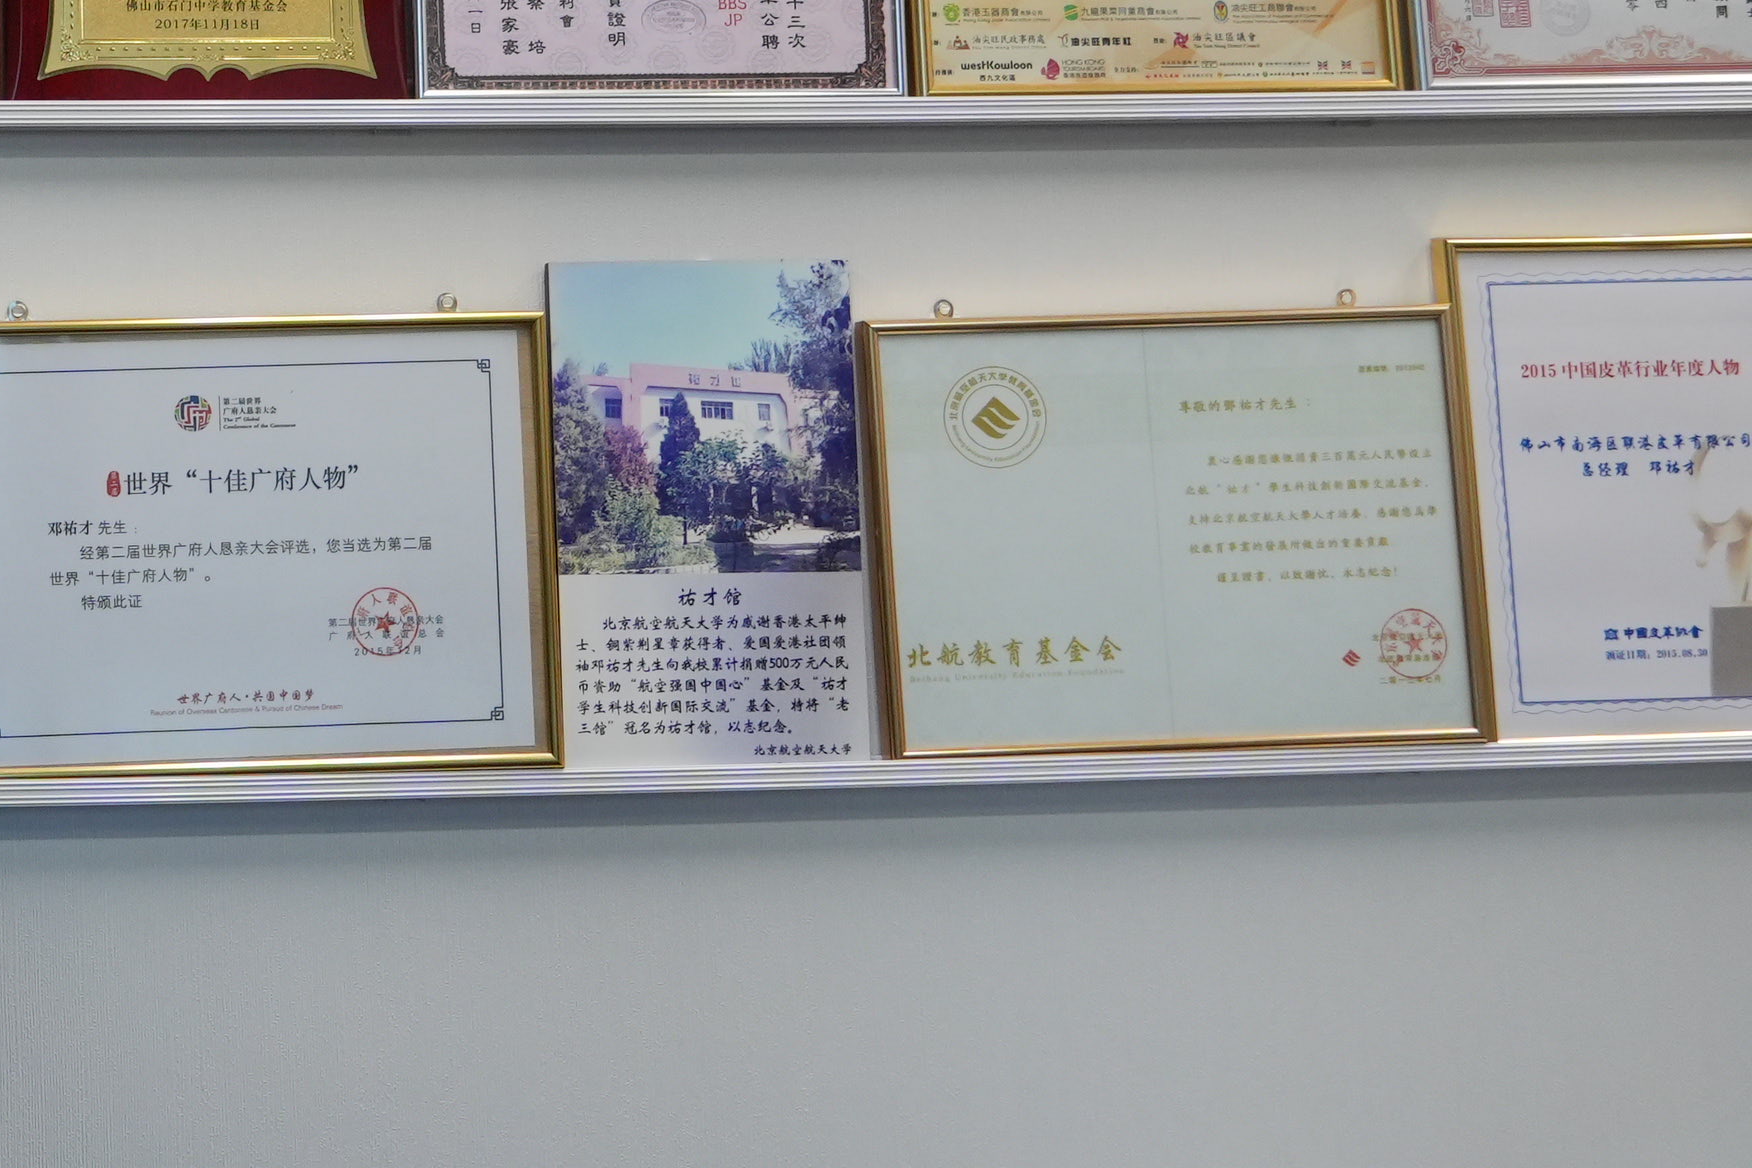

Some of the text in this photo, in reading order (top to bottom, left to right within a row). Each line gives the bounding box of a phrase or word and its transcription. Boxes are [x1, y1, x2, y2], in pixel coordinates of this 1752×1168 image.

[126, 0, 288, 12] 佛山市石门中学教育基金会
[155, 18, 259, 31] 2017年11月18日
[724, 14, 742, 26] JP
[1521, 359, 1740, 379] 2015 中国皮革行业年度人物
[1520, 434, 1750, 453] 佛山市南海区联港皮革有限公司
[1583, 461, 1694, 477] 总经理 邓祐才
[81, 594, 142, 610] 特颁此证
[678, 588, 742, 606] 祐才馆
[603, 614, 847, 630] 北京航空航天大学为感谢香港太平绅
[576, 636, 847, 652] 士、铜紫荆星章获得者、爱国爱港社团领
[908, 636, 1122, 668] 北航教育基金会
[576, 656, 848, 673] 袖邓祐才先生向我校累计捐赠500万元人民
[754, 743, 851, 756] 北京航空航天大学
